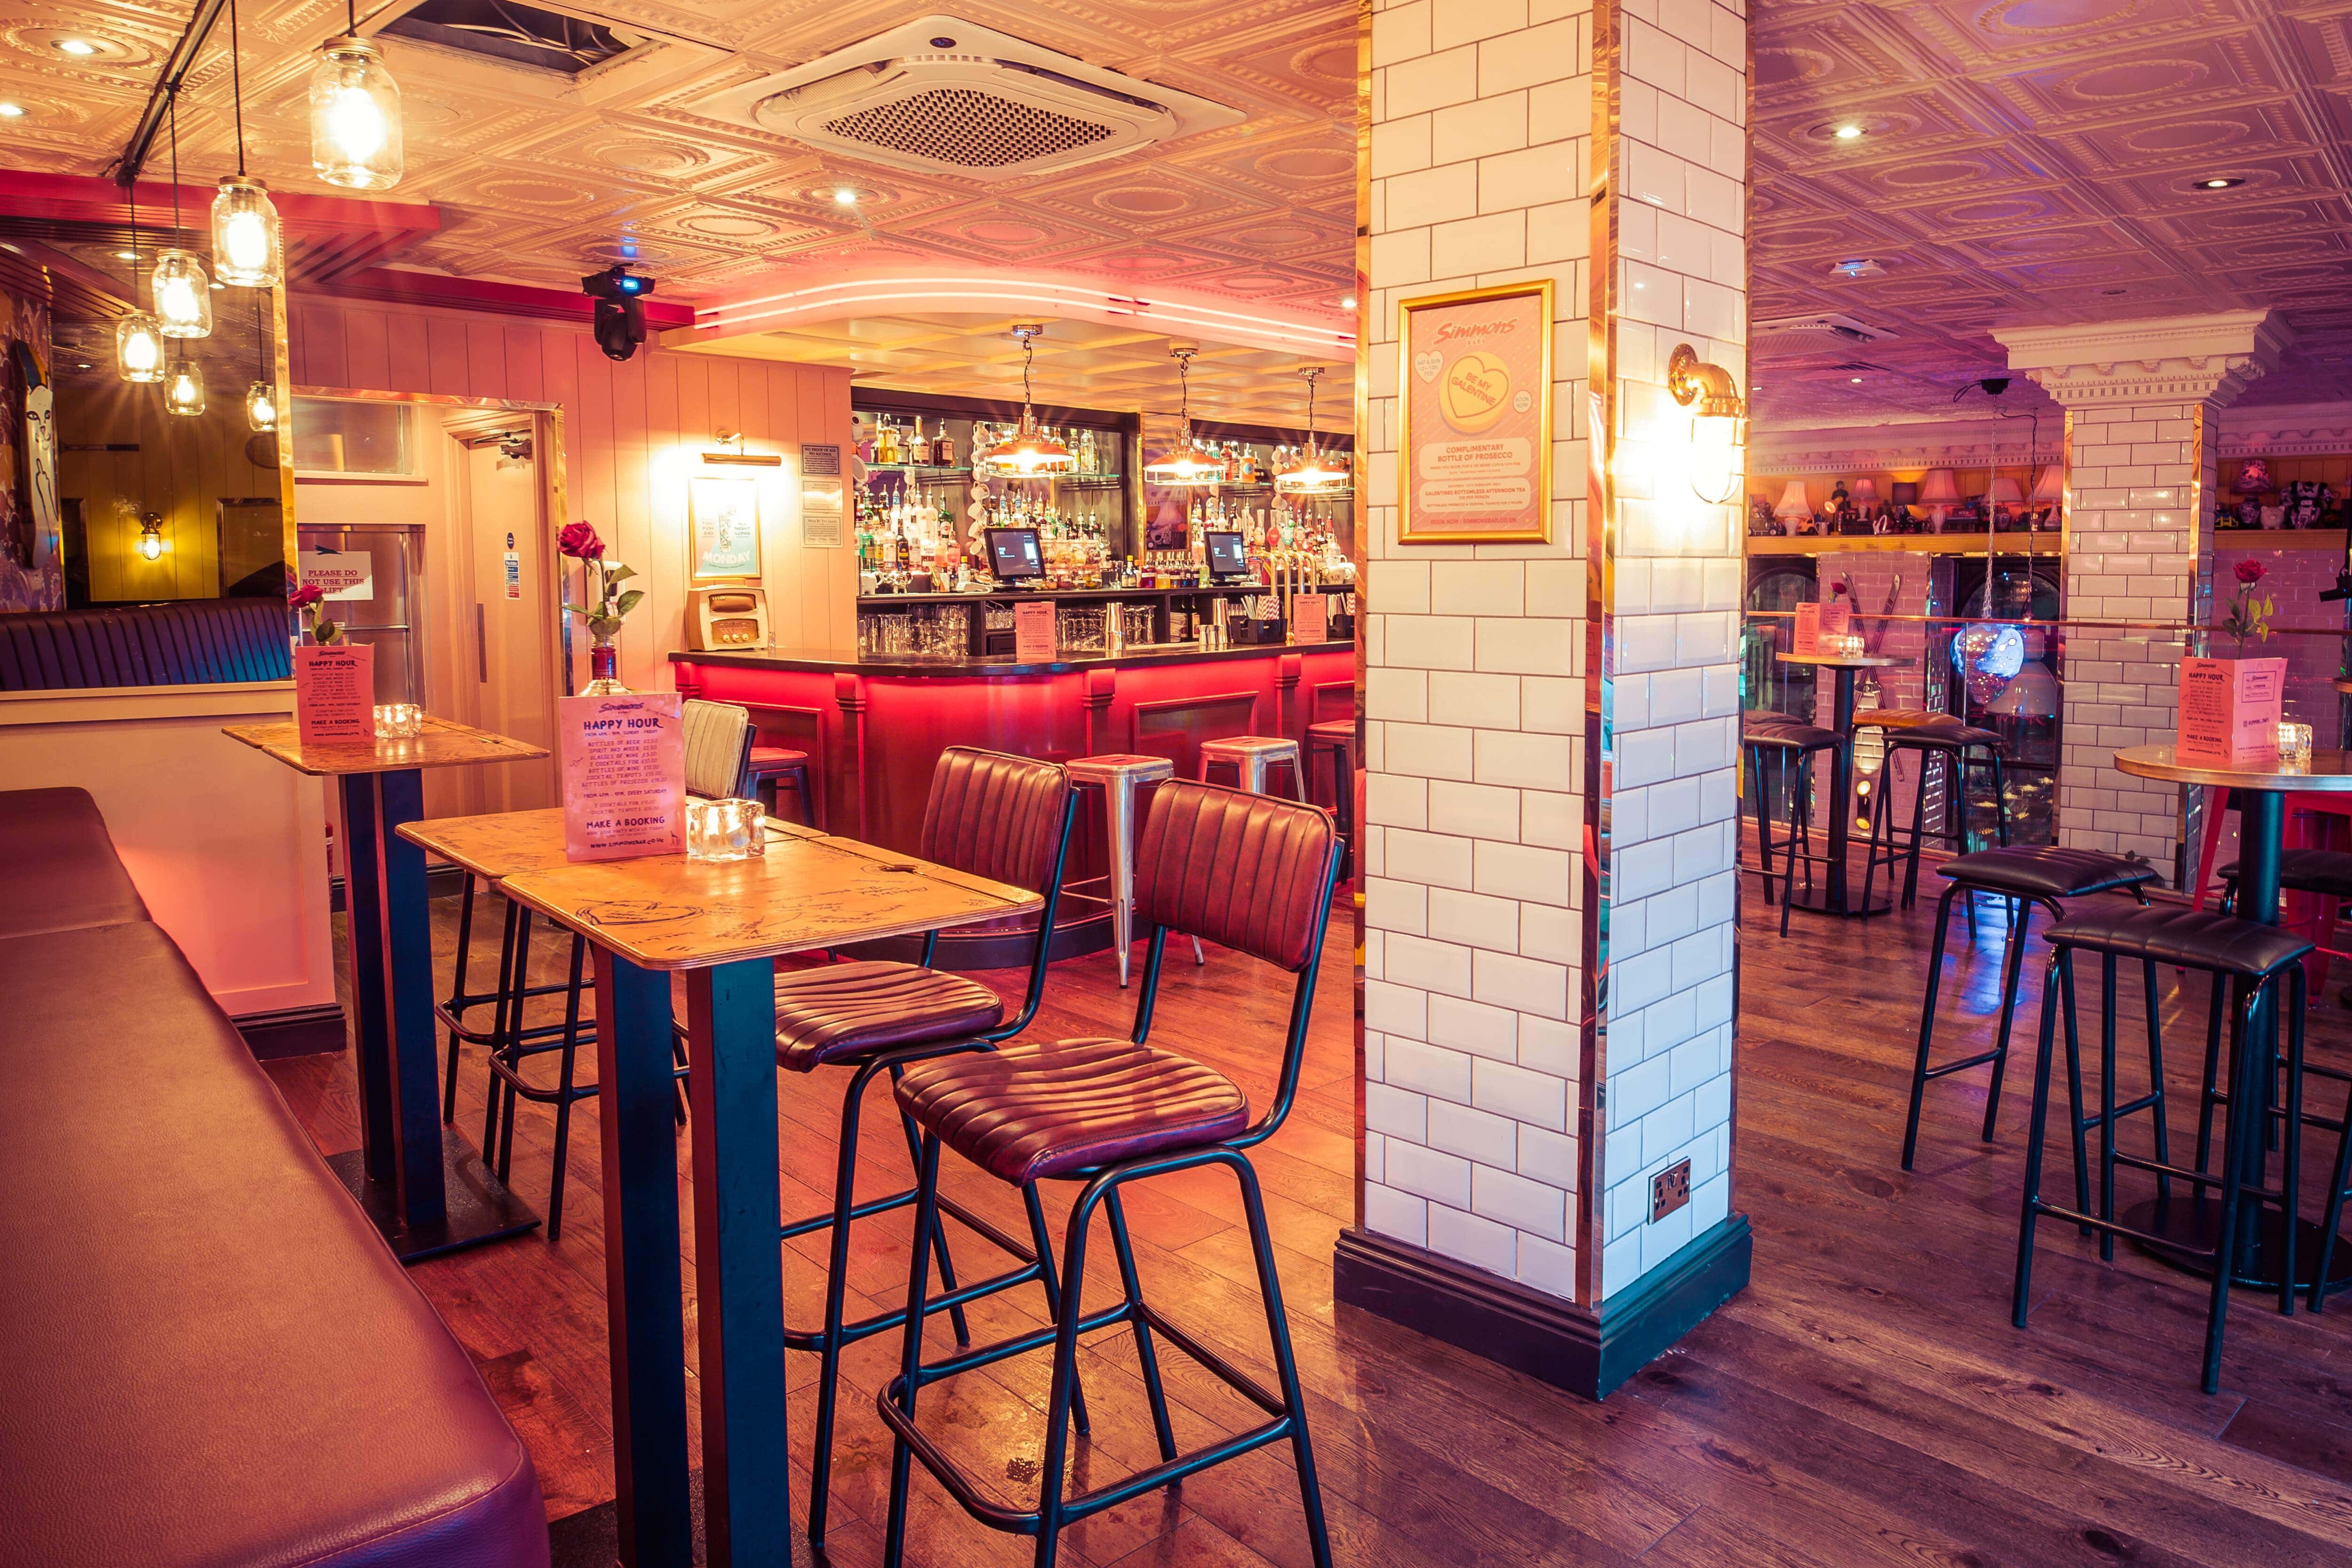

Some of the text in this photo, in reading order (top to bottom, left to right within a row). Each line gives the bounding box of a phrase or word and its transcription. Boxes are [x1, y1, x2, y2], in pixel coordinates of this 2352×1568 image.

[1434, 318, 1517, 345] Simmons
[1465, 372, 1492, 391] BE MY
[1452, 377, 1496, 405] GALENTINE
[1446, 444, 1504, 454] COMPLIMENTARY
[702, 550, 750, 564] MONDAY
[584, 718, 664, 730] HAPPY HOUR
[586, 820, 611, 828] MAKE
[624, 816, 665, 826] BOOKING
